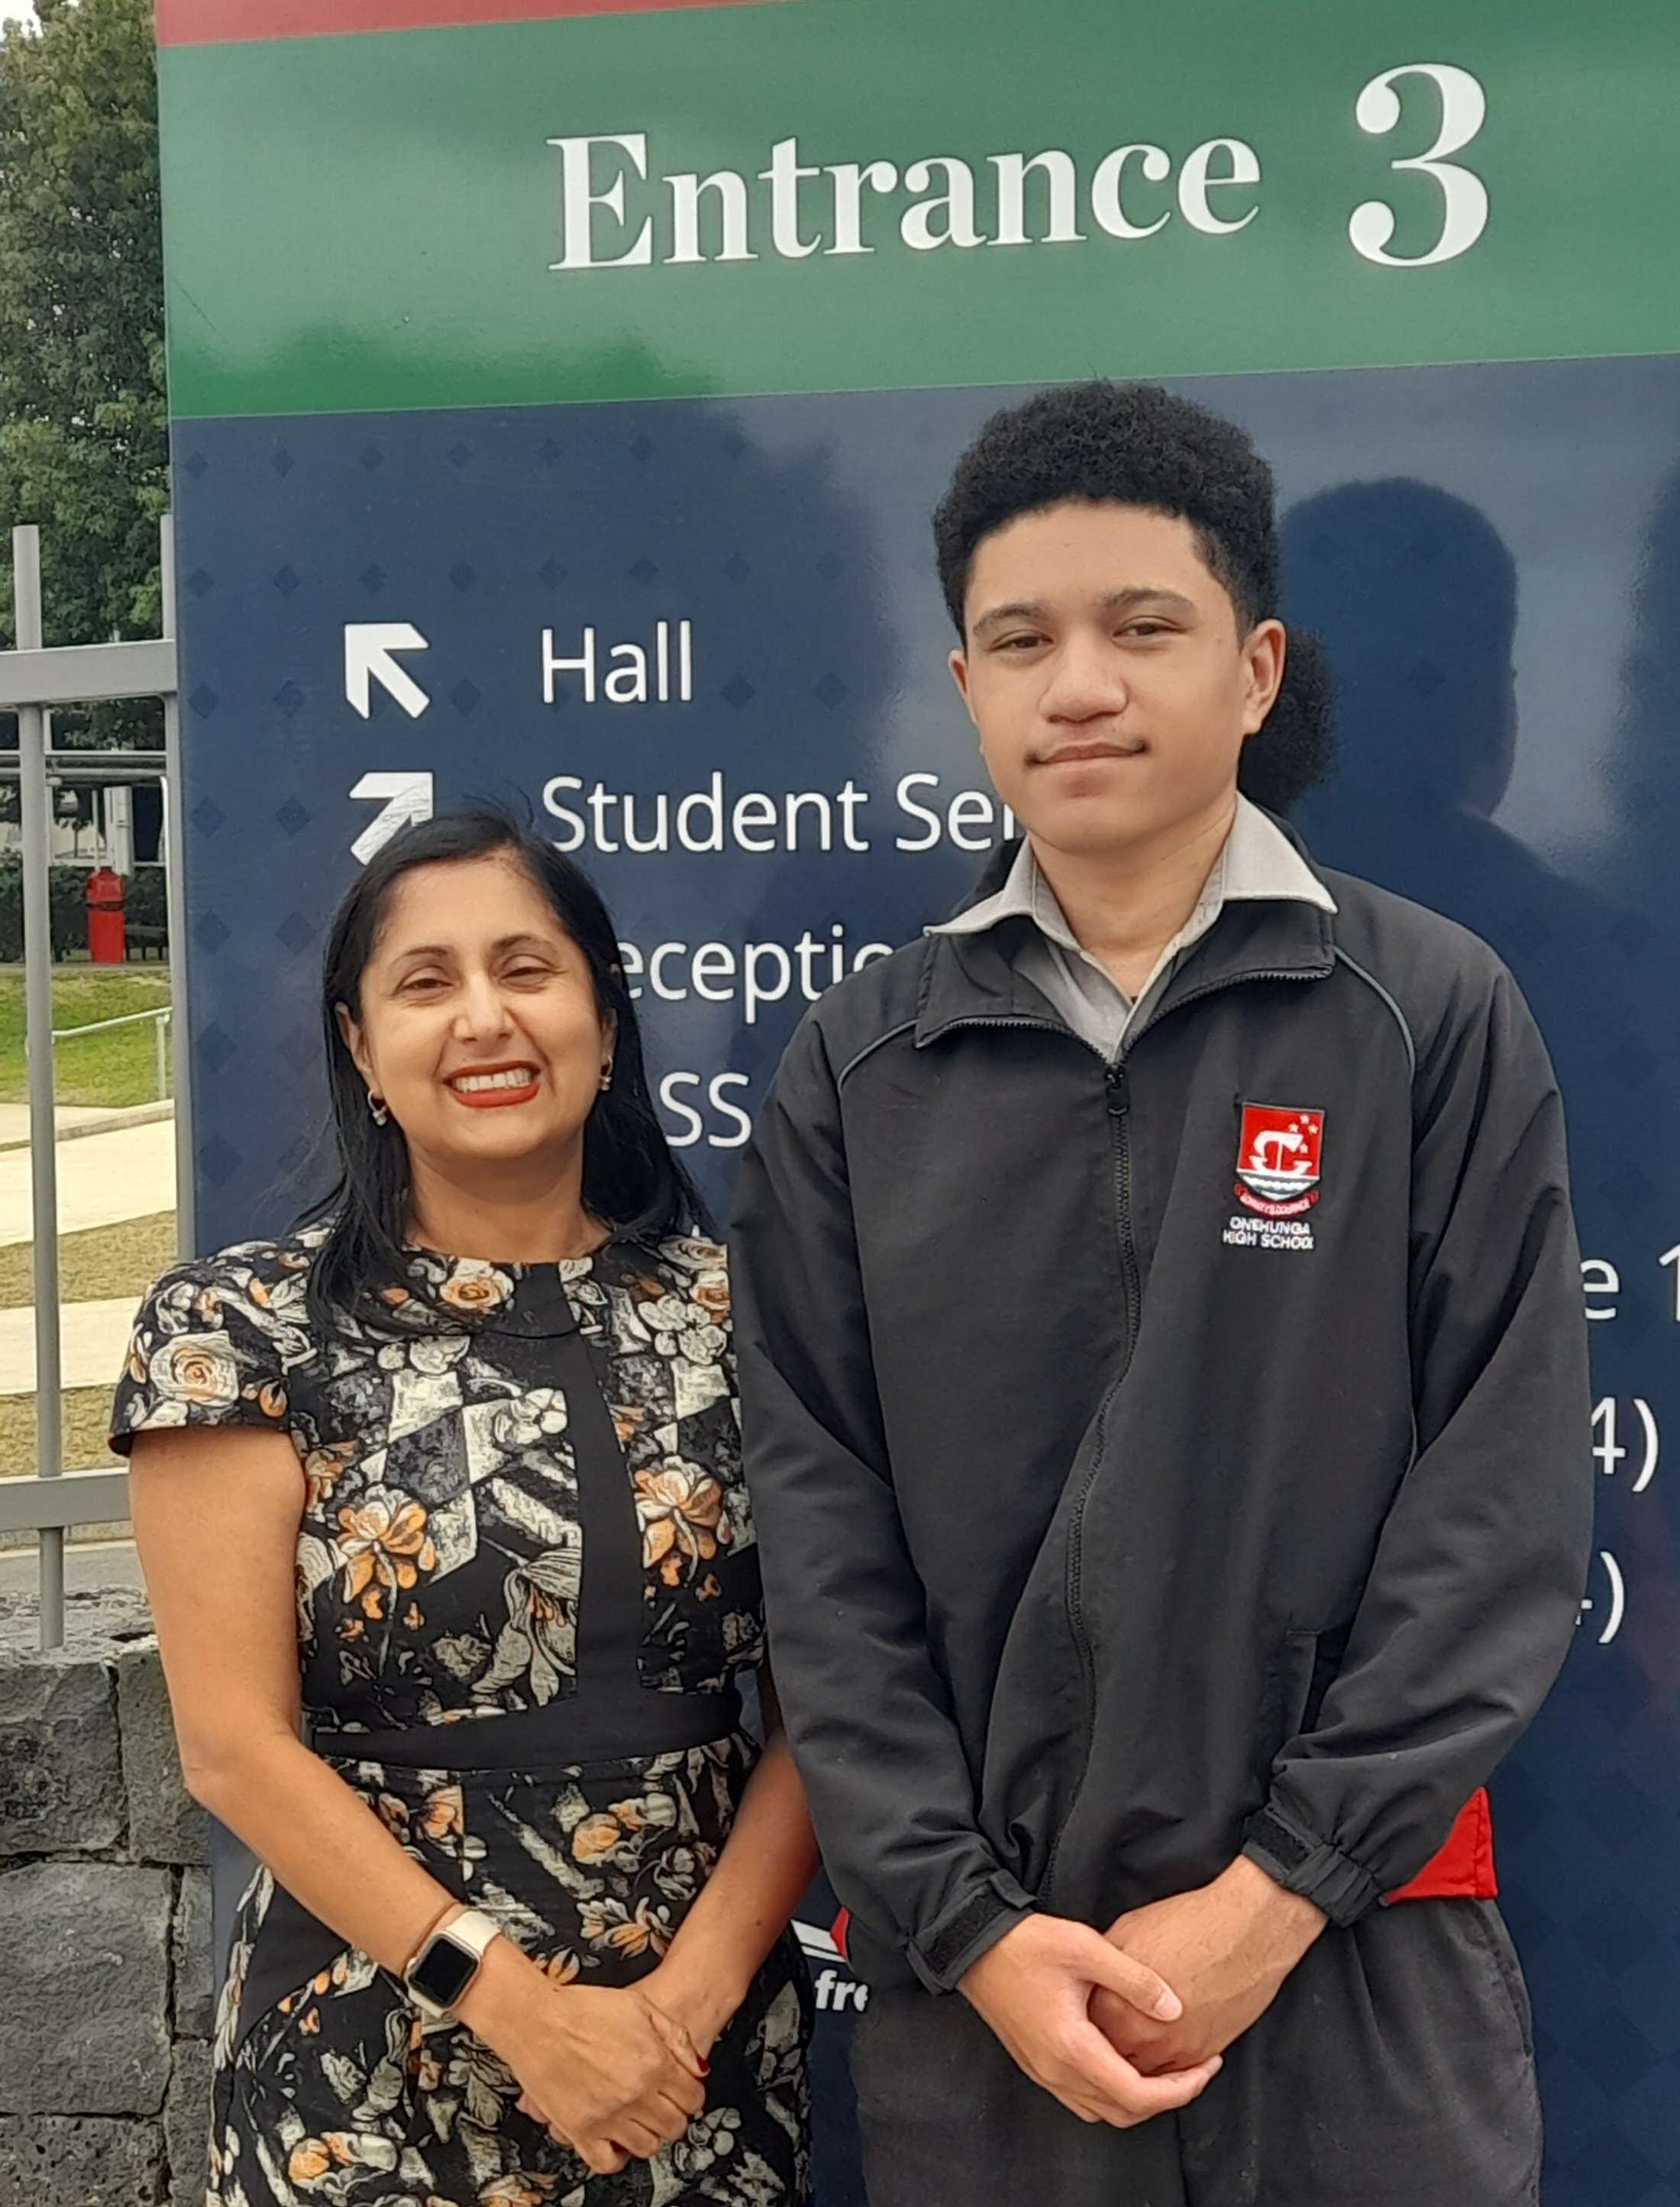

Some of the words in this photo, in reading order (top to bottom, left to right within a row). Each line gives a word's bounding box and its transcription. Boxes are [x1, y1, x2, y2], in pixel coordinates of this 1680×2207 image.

[546, 133, 1261, 270] Entrance
[1348, 63, 1489, 267] 3
[541, 619, 692, 703] Hall
[542, 771, 869, 853] Student
[1223, 1230, 1257, 1246] HIGH
[1260, 1233, 1314, 1250] SCHOOL
[1229, 1216, 1310, 1235] ONEHUNGA
